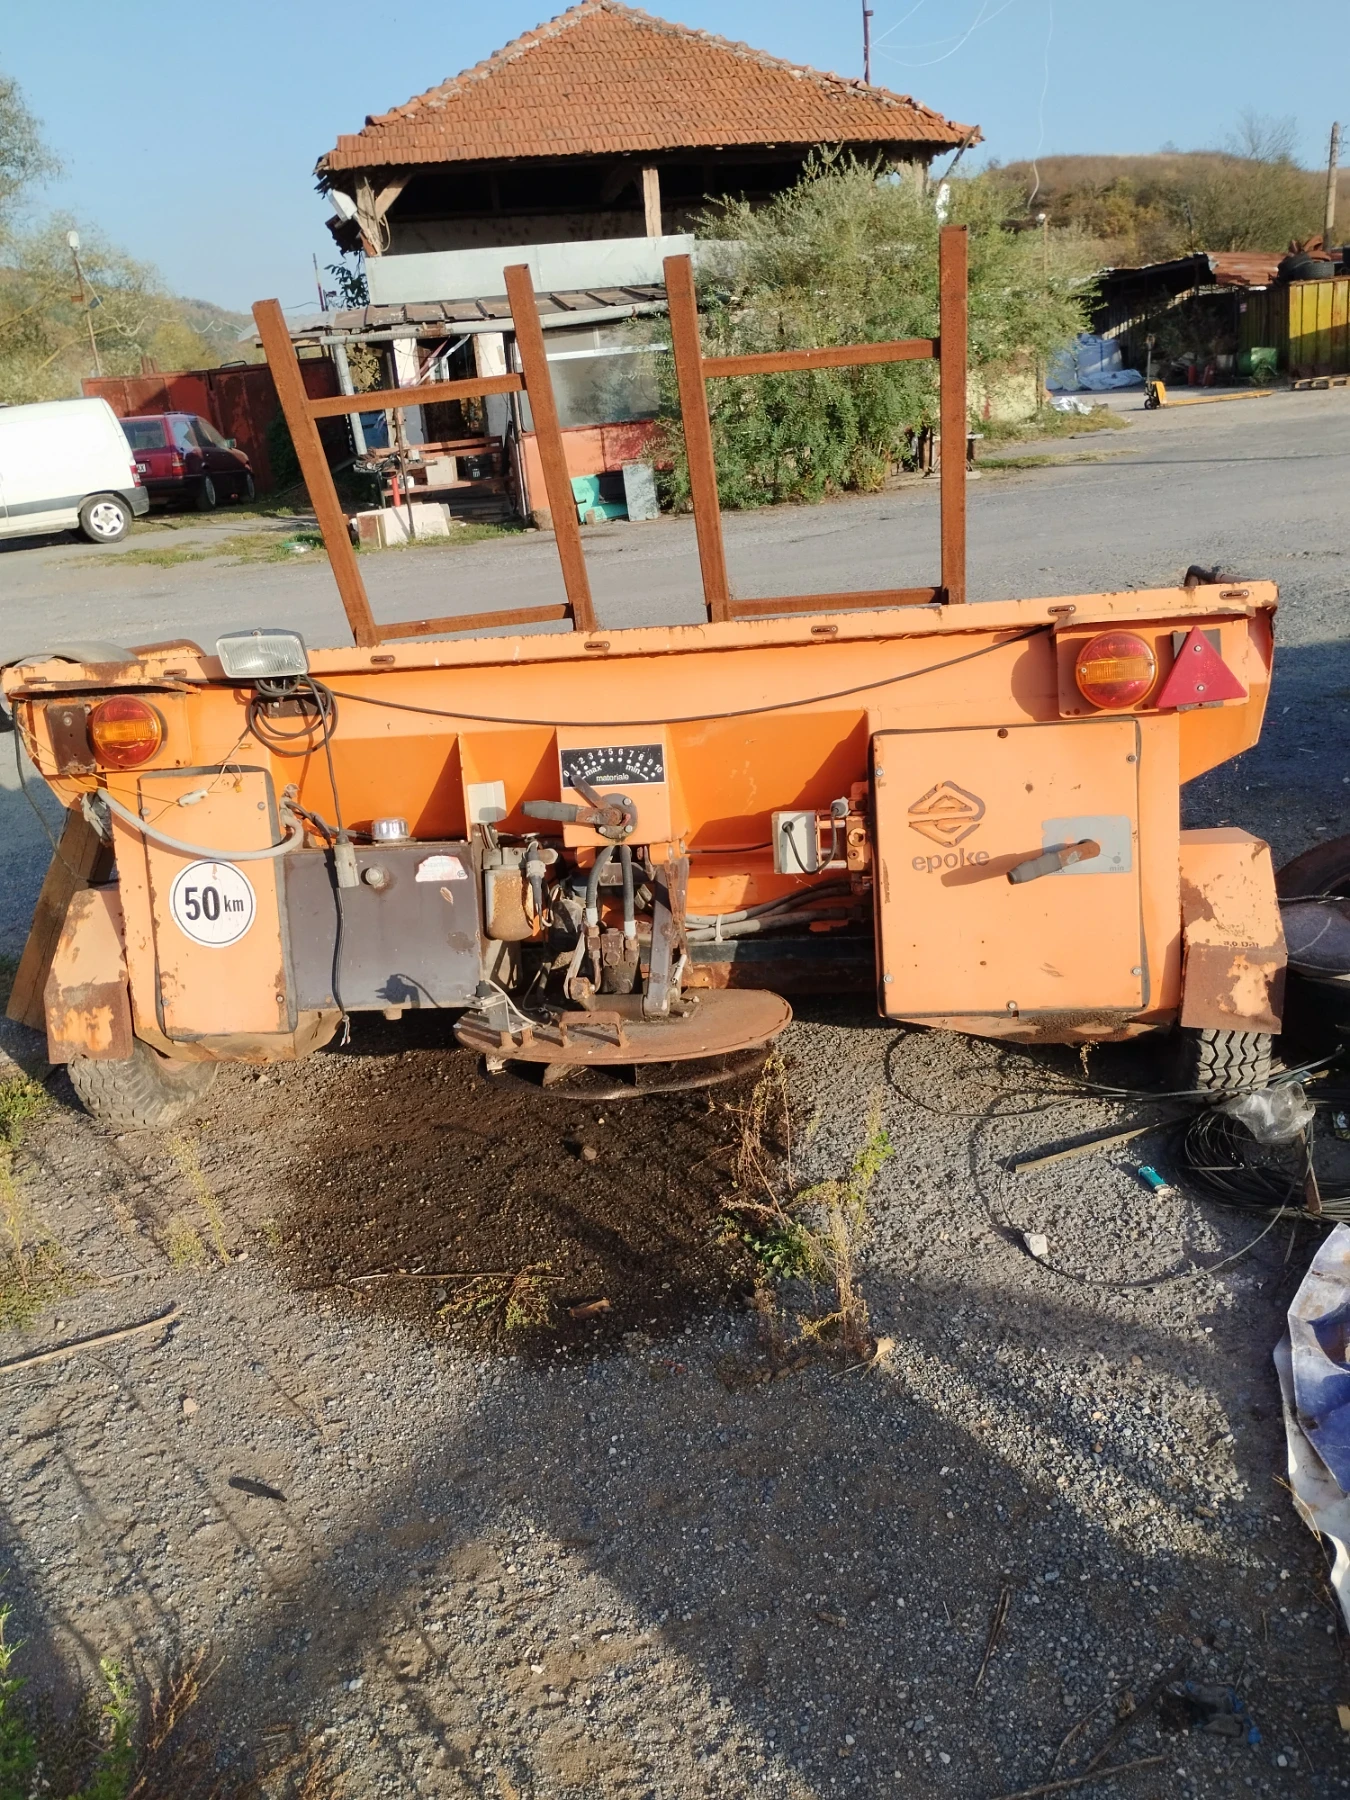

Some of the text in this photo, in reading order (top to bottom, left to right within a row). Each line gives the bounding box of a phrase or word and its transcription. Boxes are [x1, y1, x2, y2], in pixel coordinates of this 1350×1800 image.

[570, 763, 579, 771] 1
[578, 757, 586, 765] 2
[587, 752, 594, 760] 3
[597, 749, 604, 757] 4
[608, 748, 614, 756] 5
[618, 748, 624, 756] 6
[629, 749, 635, 758] 7
[638, 753, 645, 761] 8
[646, 758, 654, 766] 9
[654, 764, 663, 773] 10
[625, 764, 641, 775] min
[585, 765, 602, 777] max
[911, 848, 990, 874] epoke
[1109, 864, 1125, 872] min
[184, 886, 244, 921] 50 km
